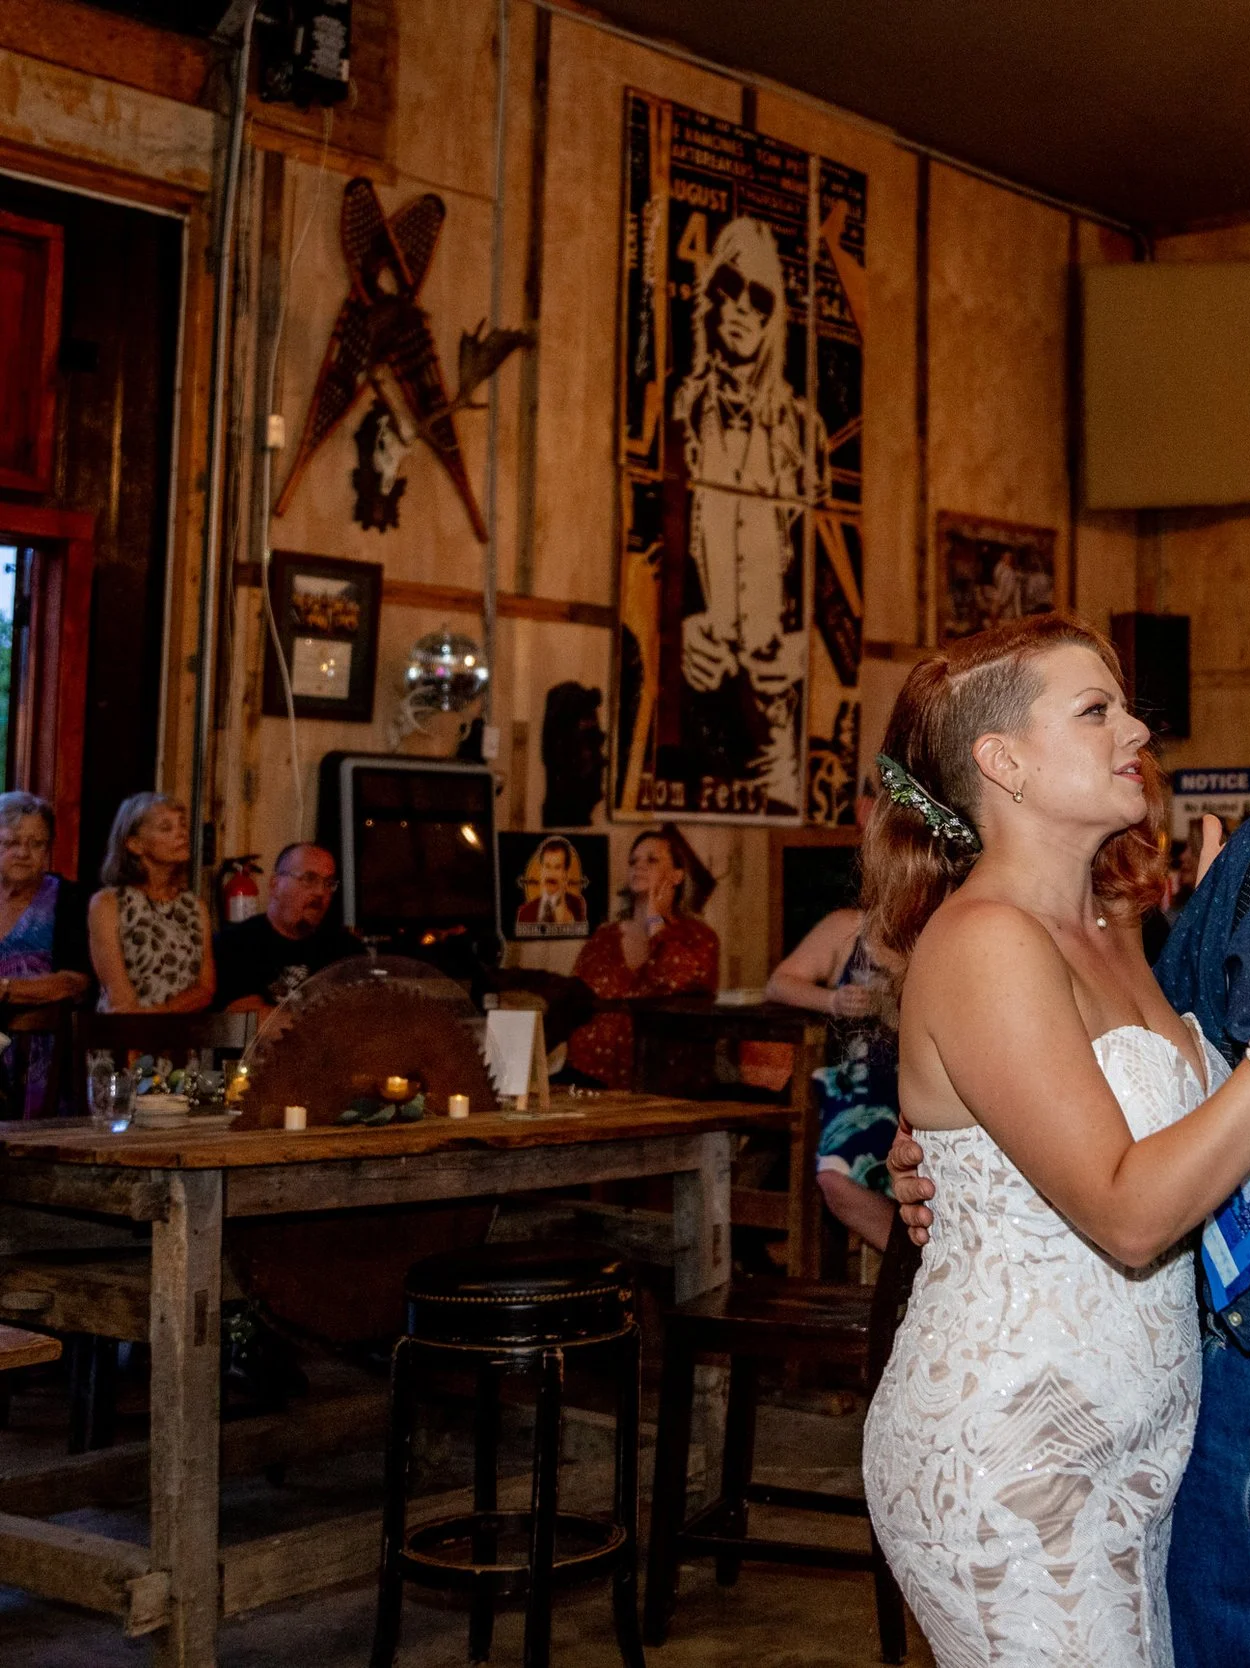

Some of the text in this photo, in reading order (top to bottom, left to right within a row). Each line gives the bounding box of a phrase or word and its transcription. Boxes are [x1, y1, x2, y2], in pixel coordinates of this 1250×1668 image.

[640, 772, 767, 817] Tom Petty
[1181, 773, 1249, 791] NOTICE
